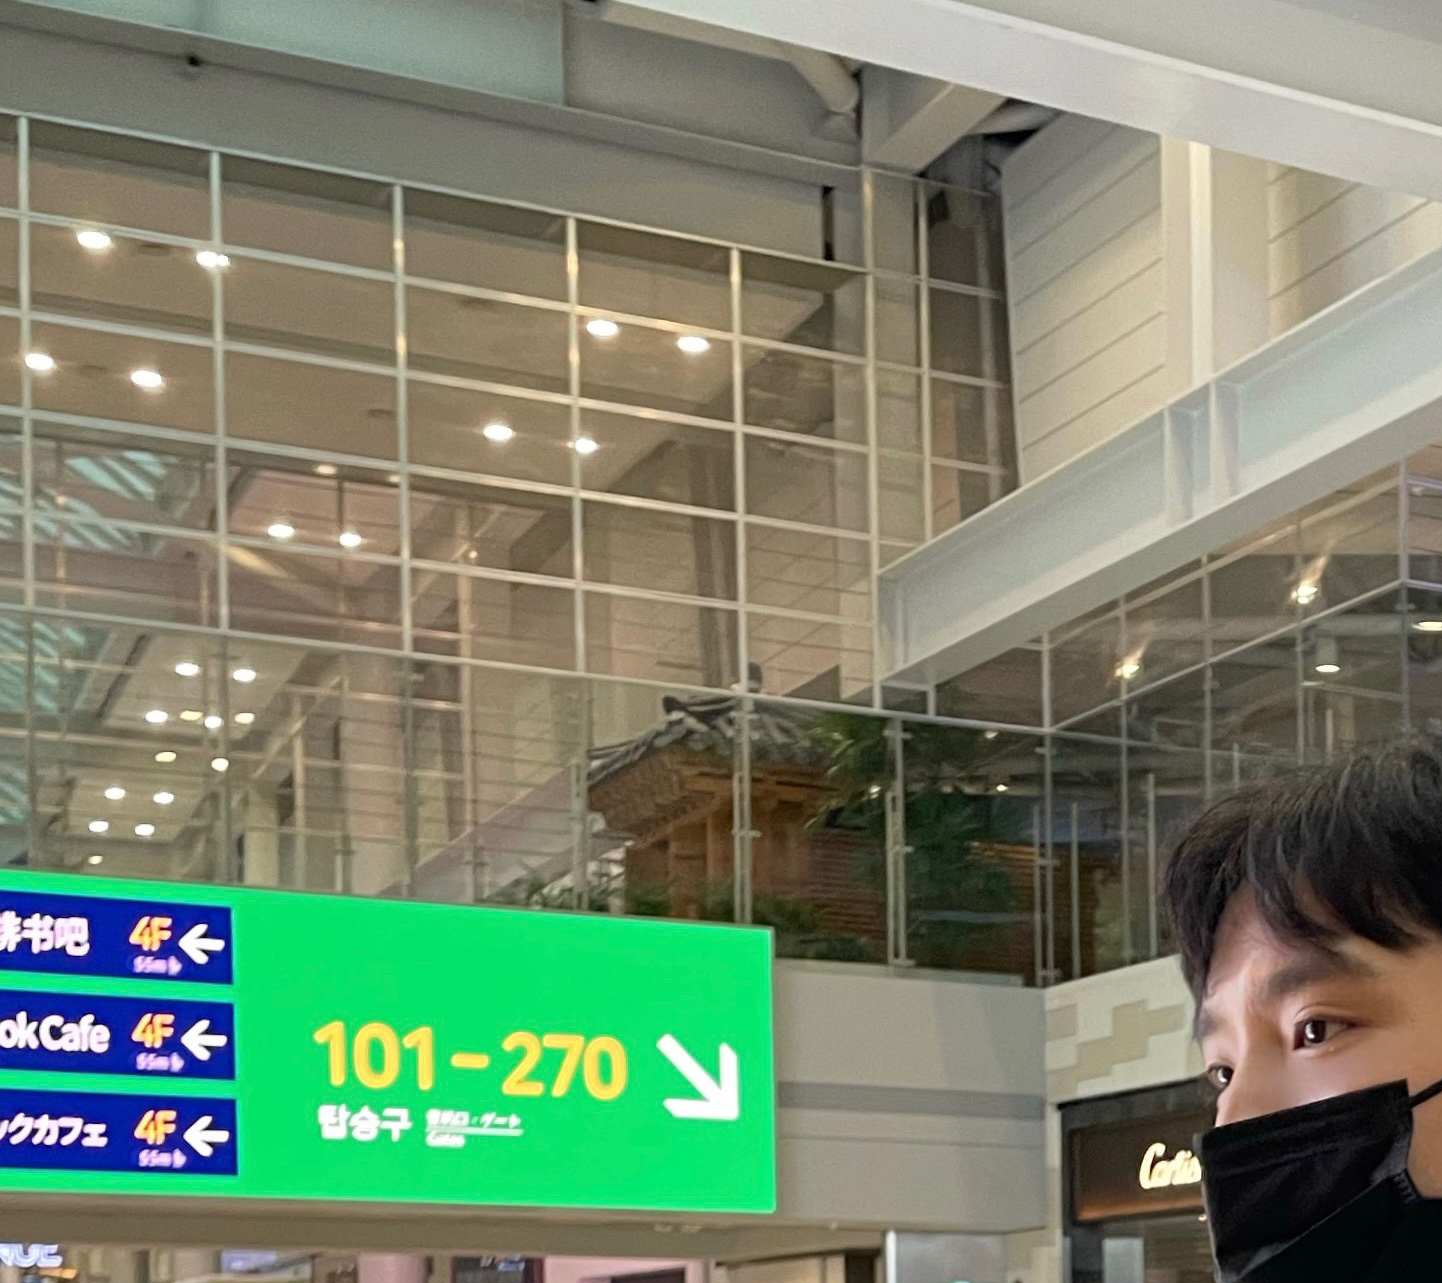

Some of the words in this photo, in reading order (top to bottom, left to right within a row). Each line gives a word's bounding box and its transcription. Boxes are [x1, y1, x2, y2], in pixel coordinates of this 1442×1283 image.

[128, 915, 173, 951] 4F
[131, 1013, 175, 1049] 4F
[134, 1109, 177, 1145] 4F
[317, 1103, 413, 1143] 탑승구
[1139, 1142, 1202, 1189] Cartie
